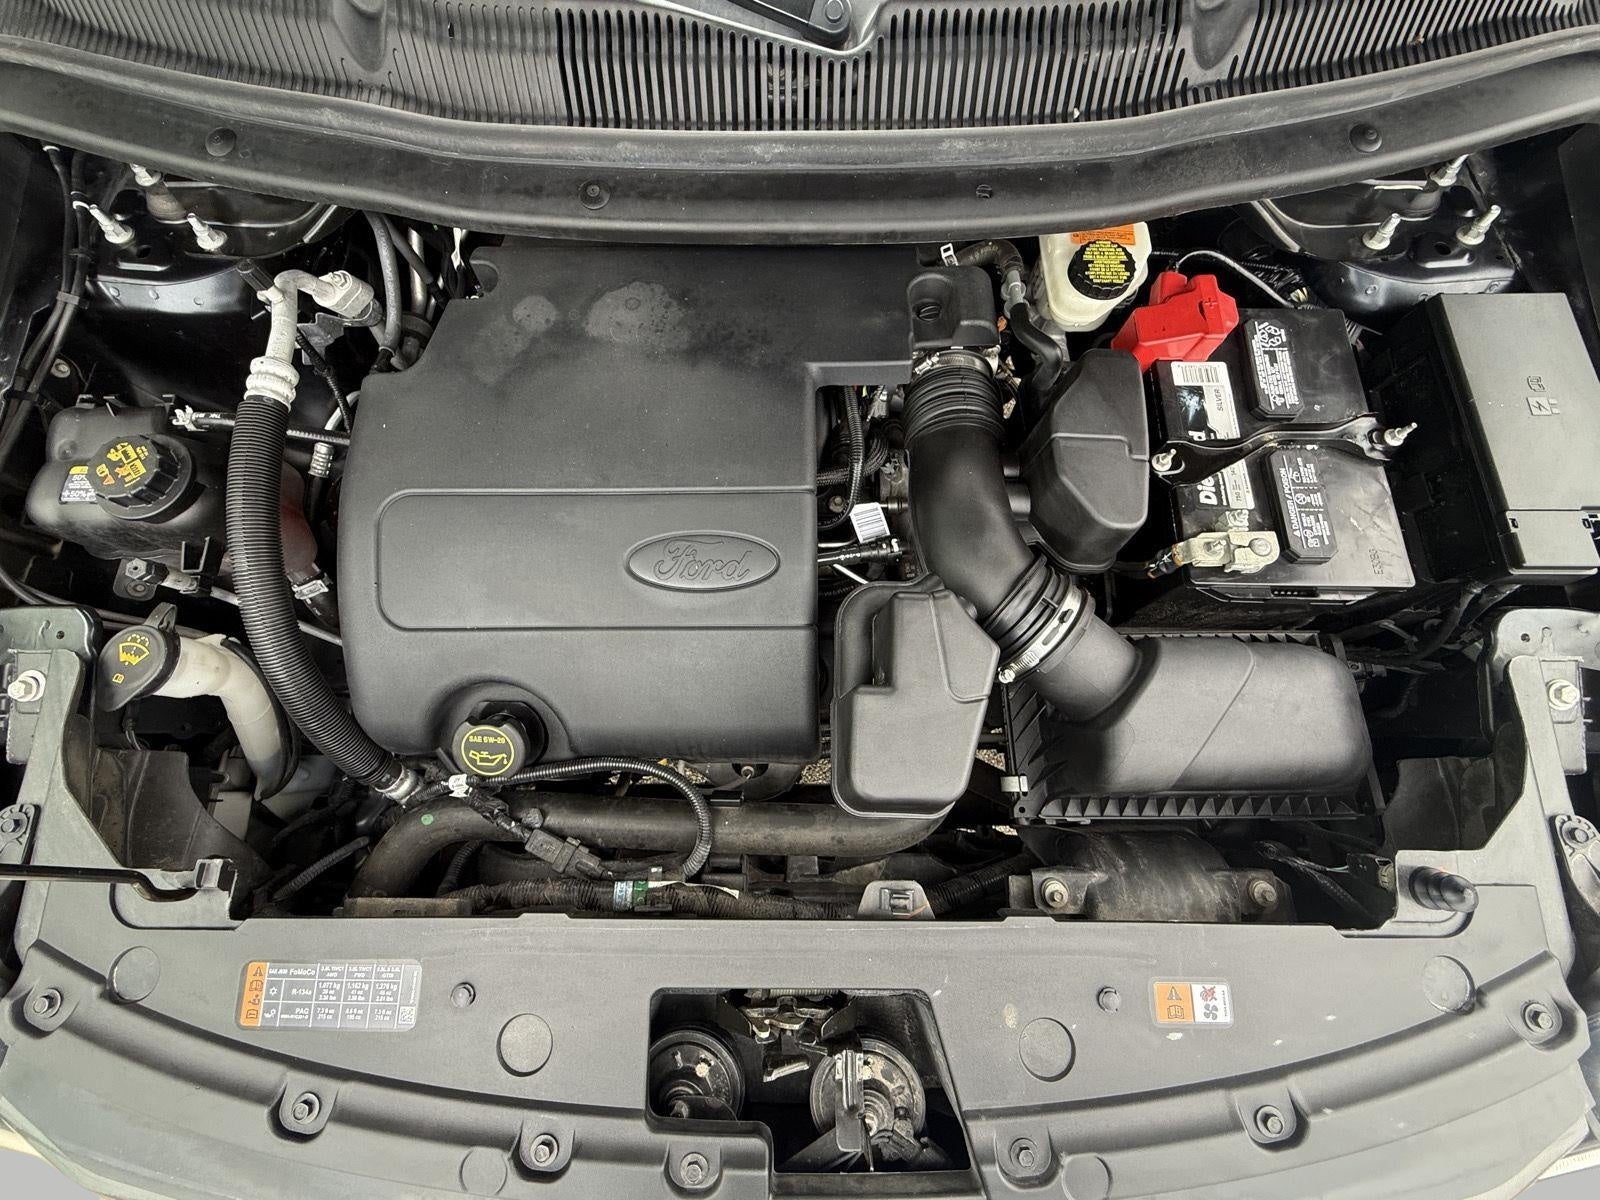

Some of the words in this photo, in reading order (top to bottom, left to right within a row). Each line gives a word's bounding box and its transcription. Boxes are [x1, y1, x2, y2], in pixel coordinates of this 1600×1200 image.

[1214, 388, 1224, 412] SILVER
[1279, 468, 1291, 494] POISON
[1287, 500, 1300, 530] DANGER
[653, 538, 752, 581] Ford
[483, 736, 506, 744] 5W-20
[290, 968, 316, 976] FoMoCo
